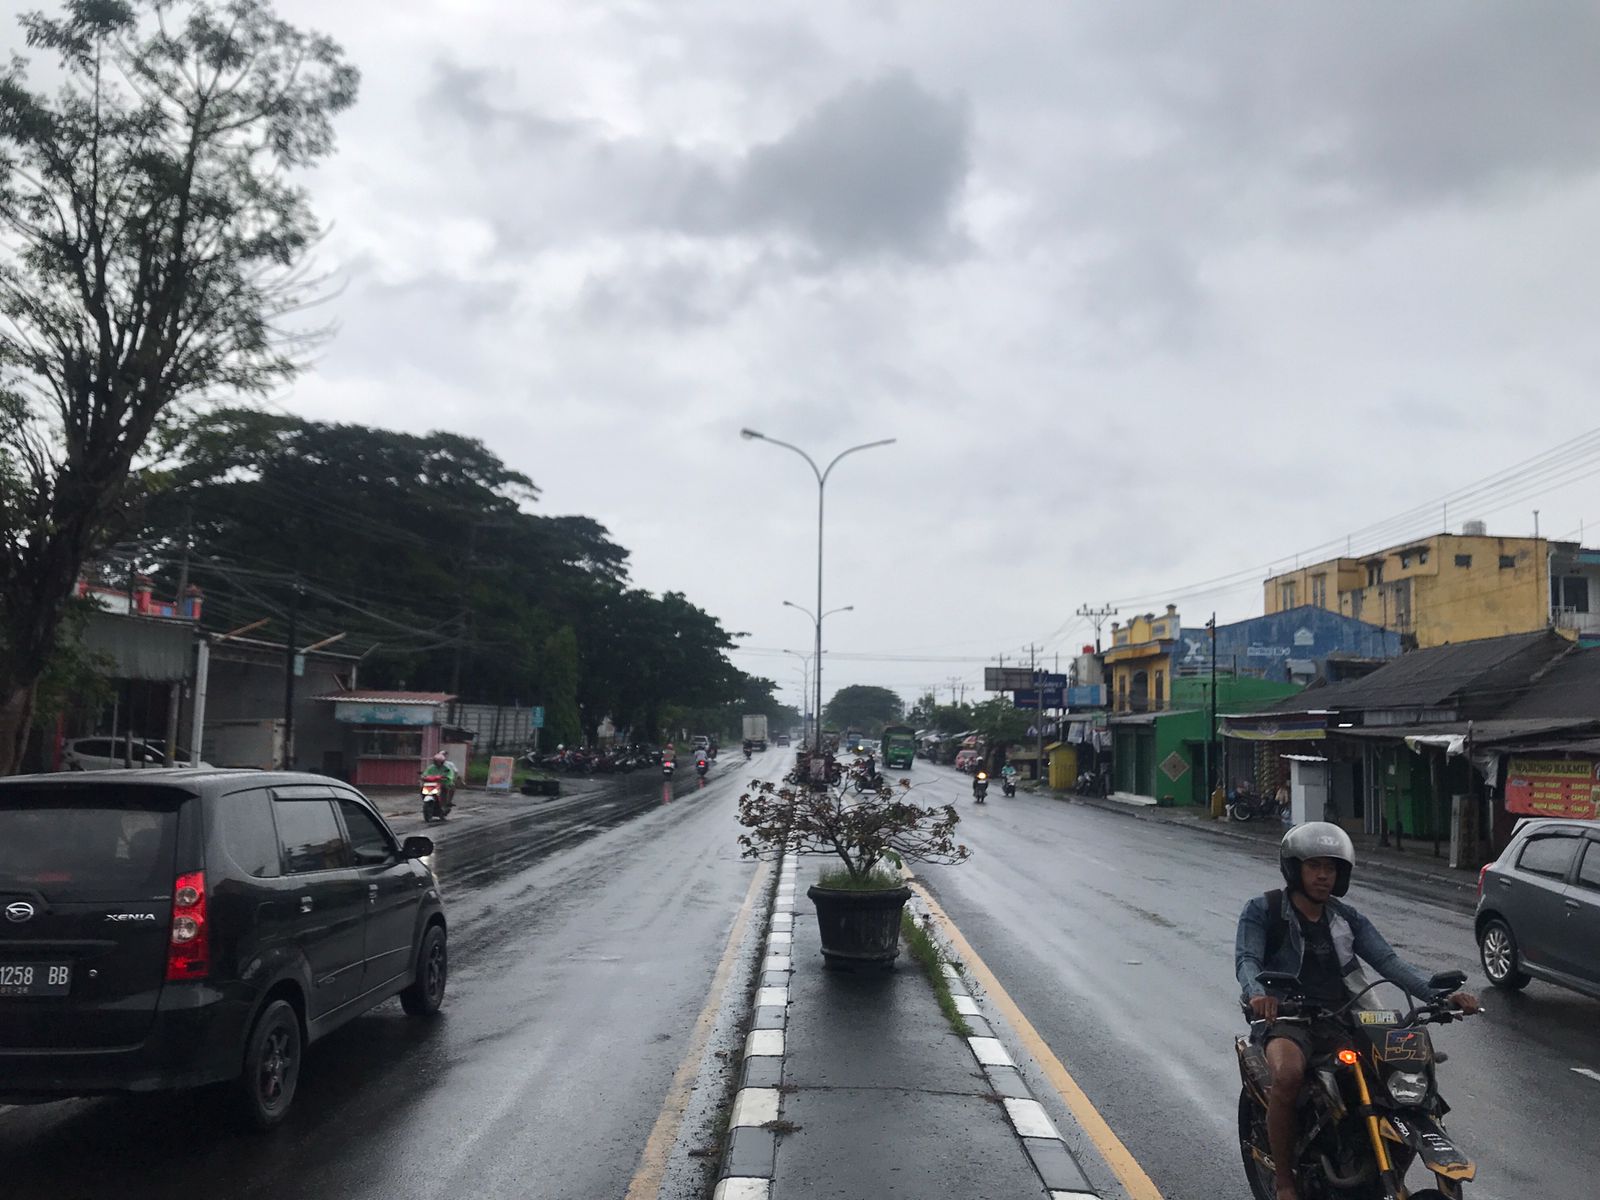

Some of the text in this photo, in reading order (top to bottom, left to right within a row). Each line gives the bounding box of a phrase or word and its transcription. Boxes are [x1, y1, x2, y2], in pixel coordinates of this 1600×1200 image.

[104, 913, 156, 922] XENIA
[0, 966, 69, 985] 1258 BB
